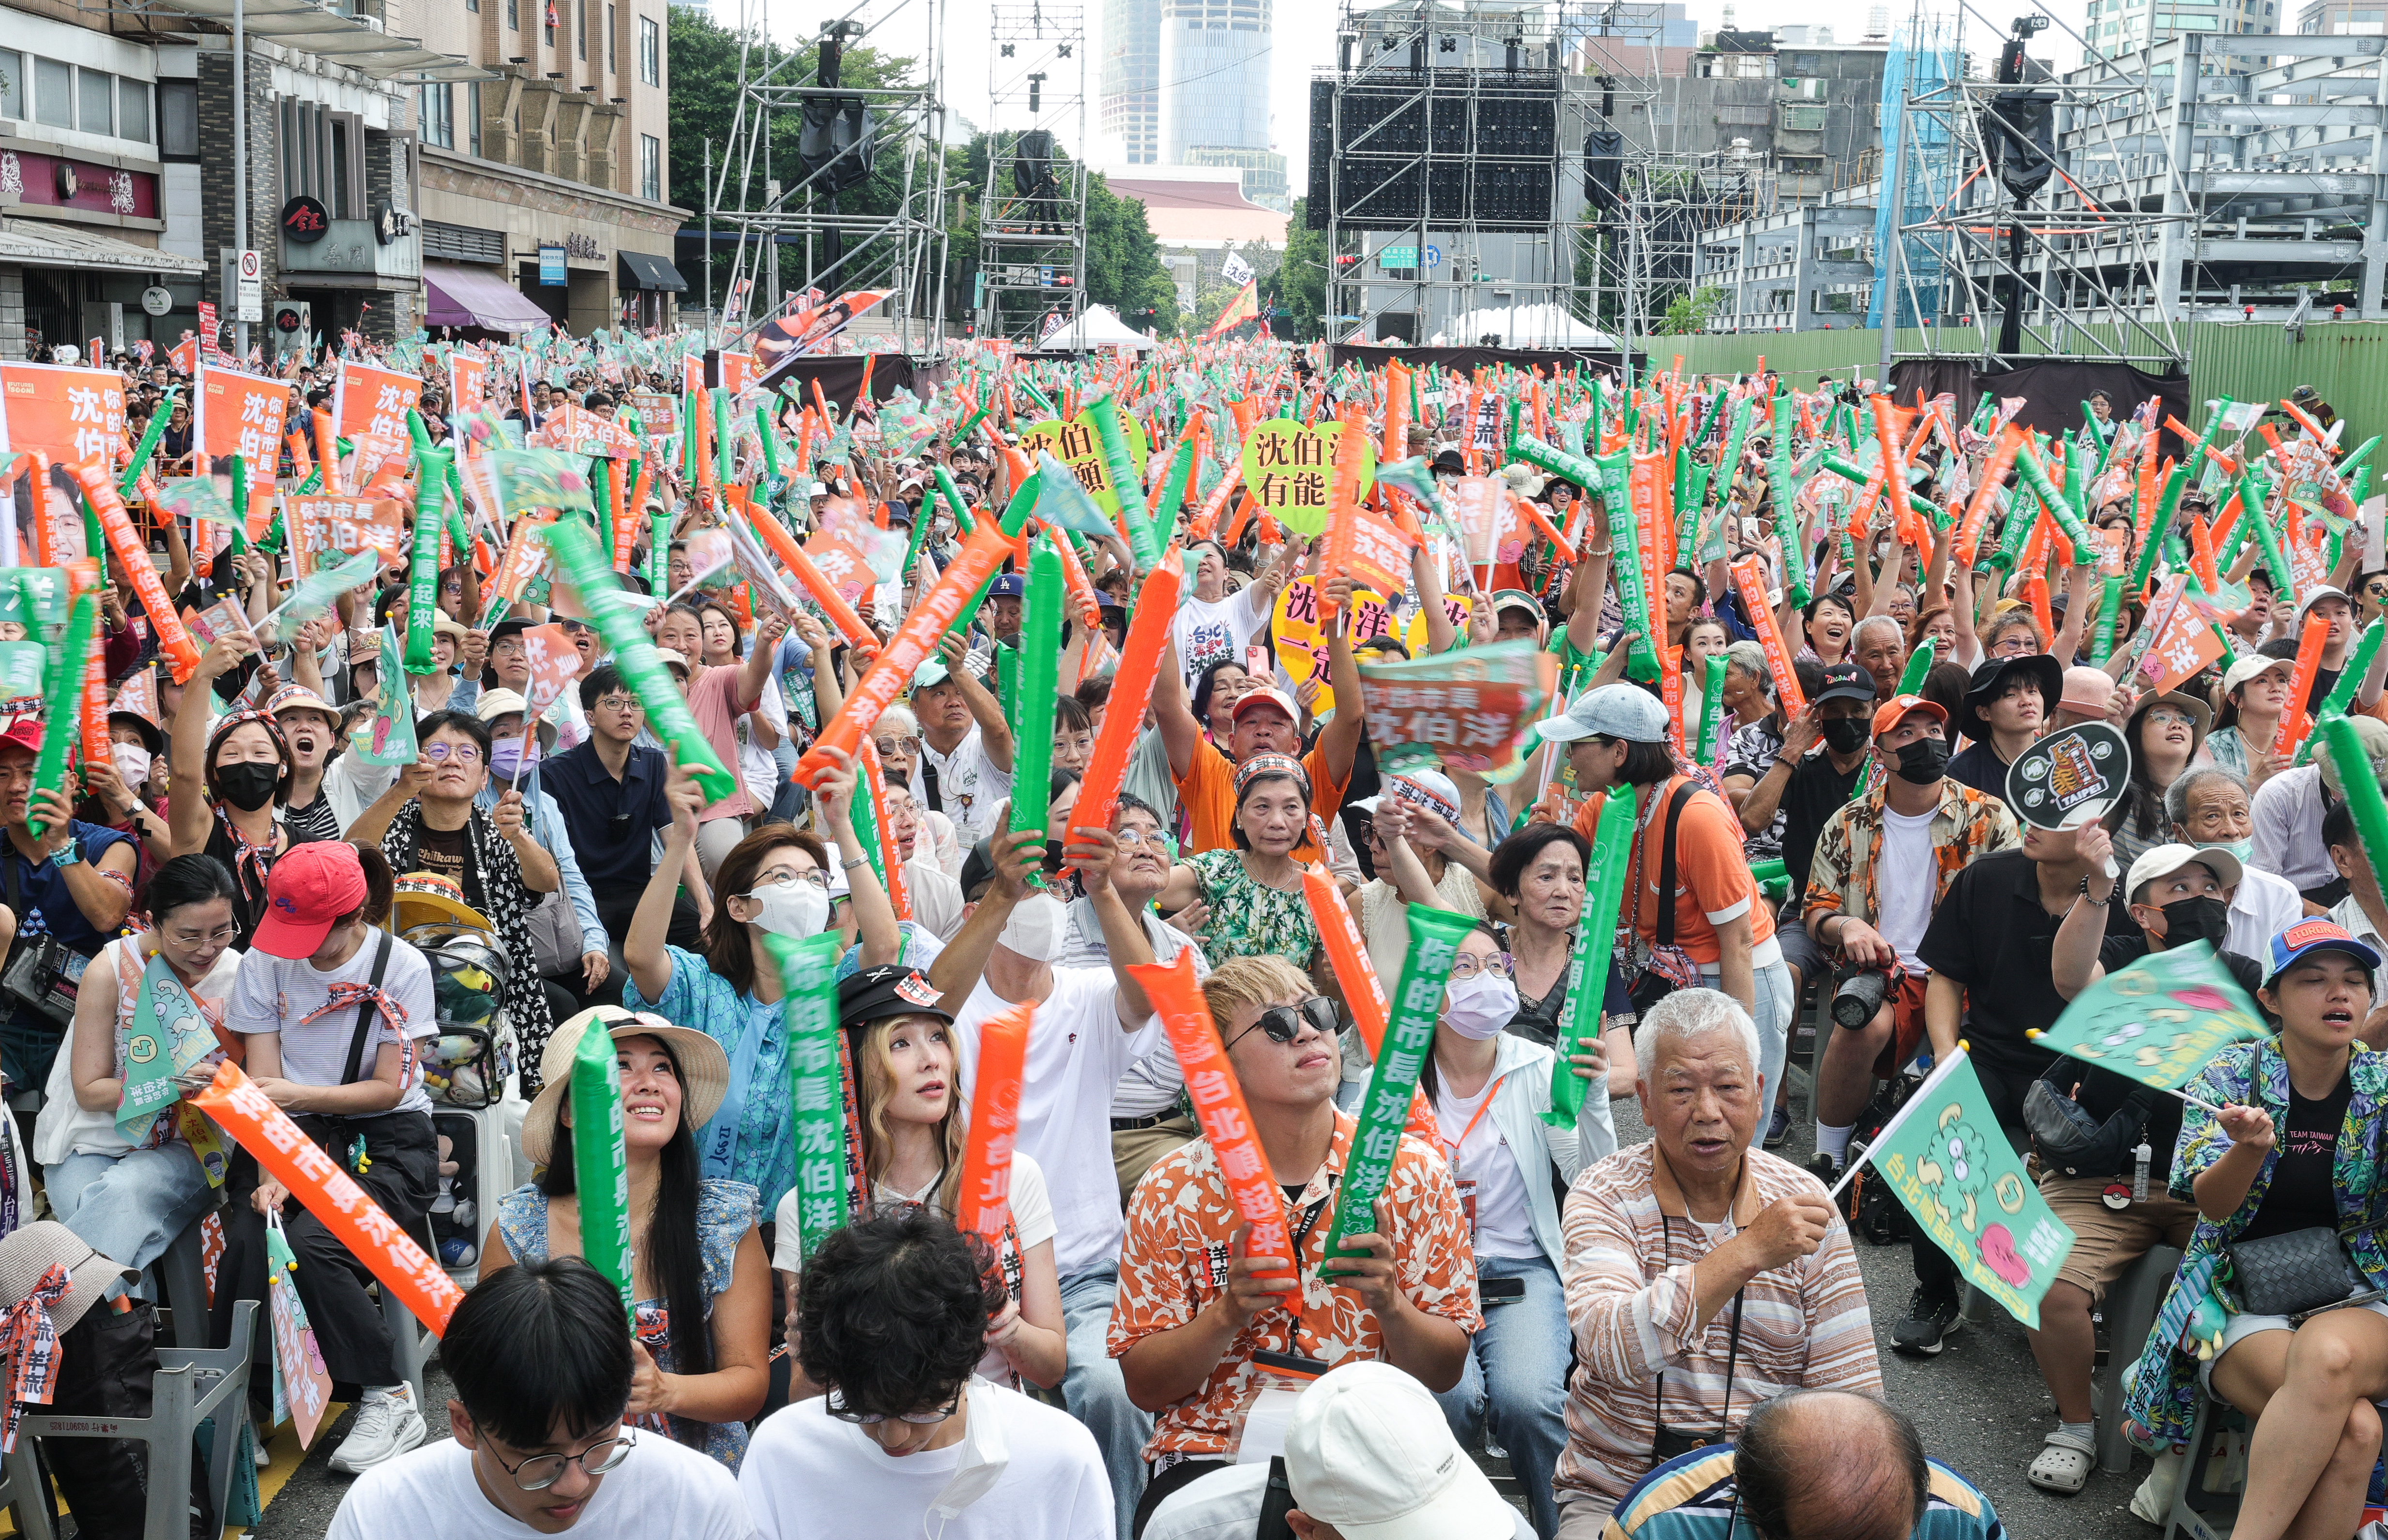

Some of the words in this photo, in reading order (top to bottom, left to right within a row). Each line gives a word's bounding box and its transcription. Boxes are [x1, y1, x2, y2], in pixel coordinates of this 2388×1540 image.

[259, 396, 283, 472] 你的市長
[574, 420, 636, 449] 沈伯洋
[117, 440, 156, 501] 台北起來
[2288, 457, 2352, 500] 沈伯
[298, 502, 374, 521] 你的市長
[79, 463, 169, 614] 市長沈伯洋
[303, 519, 396, 552] 沈伯洋
[1601, 465, 1641, 622] 你的市長沈伯洋
[2295, 537, 2327, 580] 你的市長
[1000, 577, 1010, 589] LA
[1192, 624, 1221, 644] 台北
[1737, 567, 1792, 695] 你的市長沈伯洋
[2172, 600, 2205, 639] 市長
[1194, 640, 1216, 657] 需要
[2163, 636, 2201, 675] 洋
[2061, 783, 2102, 806] TAIPEI
[785, 950, 838, 1230] 你的市長沈伯洋
[2289, 1129, 2309, 1138] TEAM
[2309, 1131, 2335, 1141] TAIWAN
[227, 1085, 458, 1308] 你的市長沈伯洋
[50, 1421, 89, 1434] 0939071825
[392, 1416, 408, 1441] HOKA
